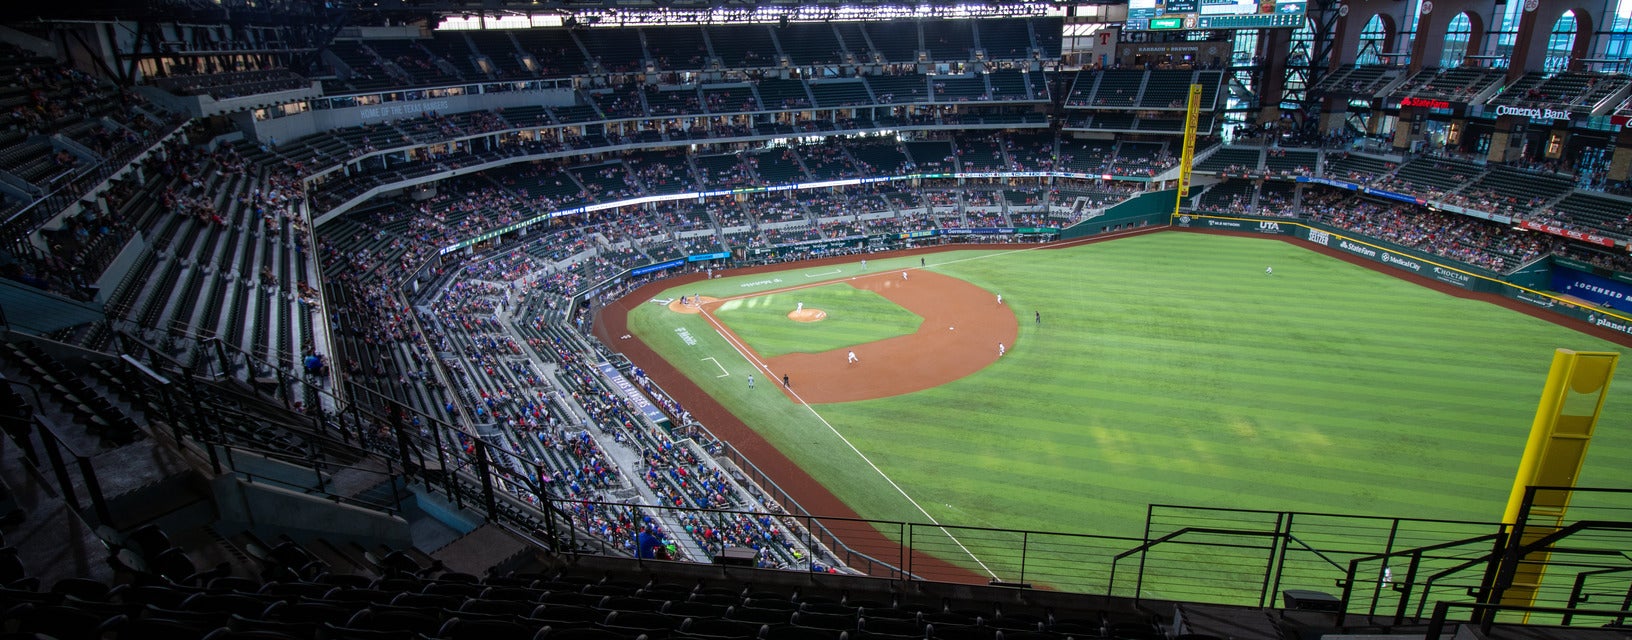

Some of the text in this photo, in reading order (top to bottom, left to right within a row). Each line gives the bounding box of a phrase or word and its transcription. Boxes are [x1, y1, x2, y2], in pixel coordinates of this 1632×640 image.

[1099, 32, 1112, 46] T
[360, 100, 449, 119] HOME OF THE TEXAS RANGERS
[1544, 107, 1572, 120] Bank
[1259, 221, 1280, 230] UTA
[1308, 231, 1329, 246] SELTZER
[1390, 256, 1410, 268] Medical
[1435, 266, 1470, 282] CHOCTAW
[1574, 281, 1623, 299] LOCKHEED
[1596, 318, 1626, 332] planet
